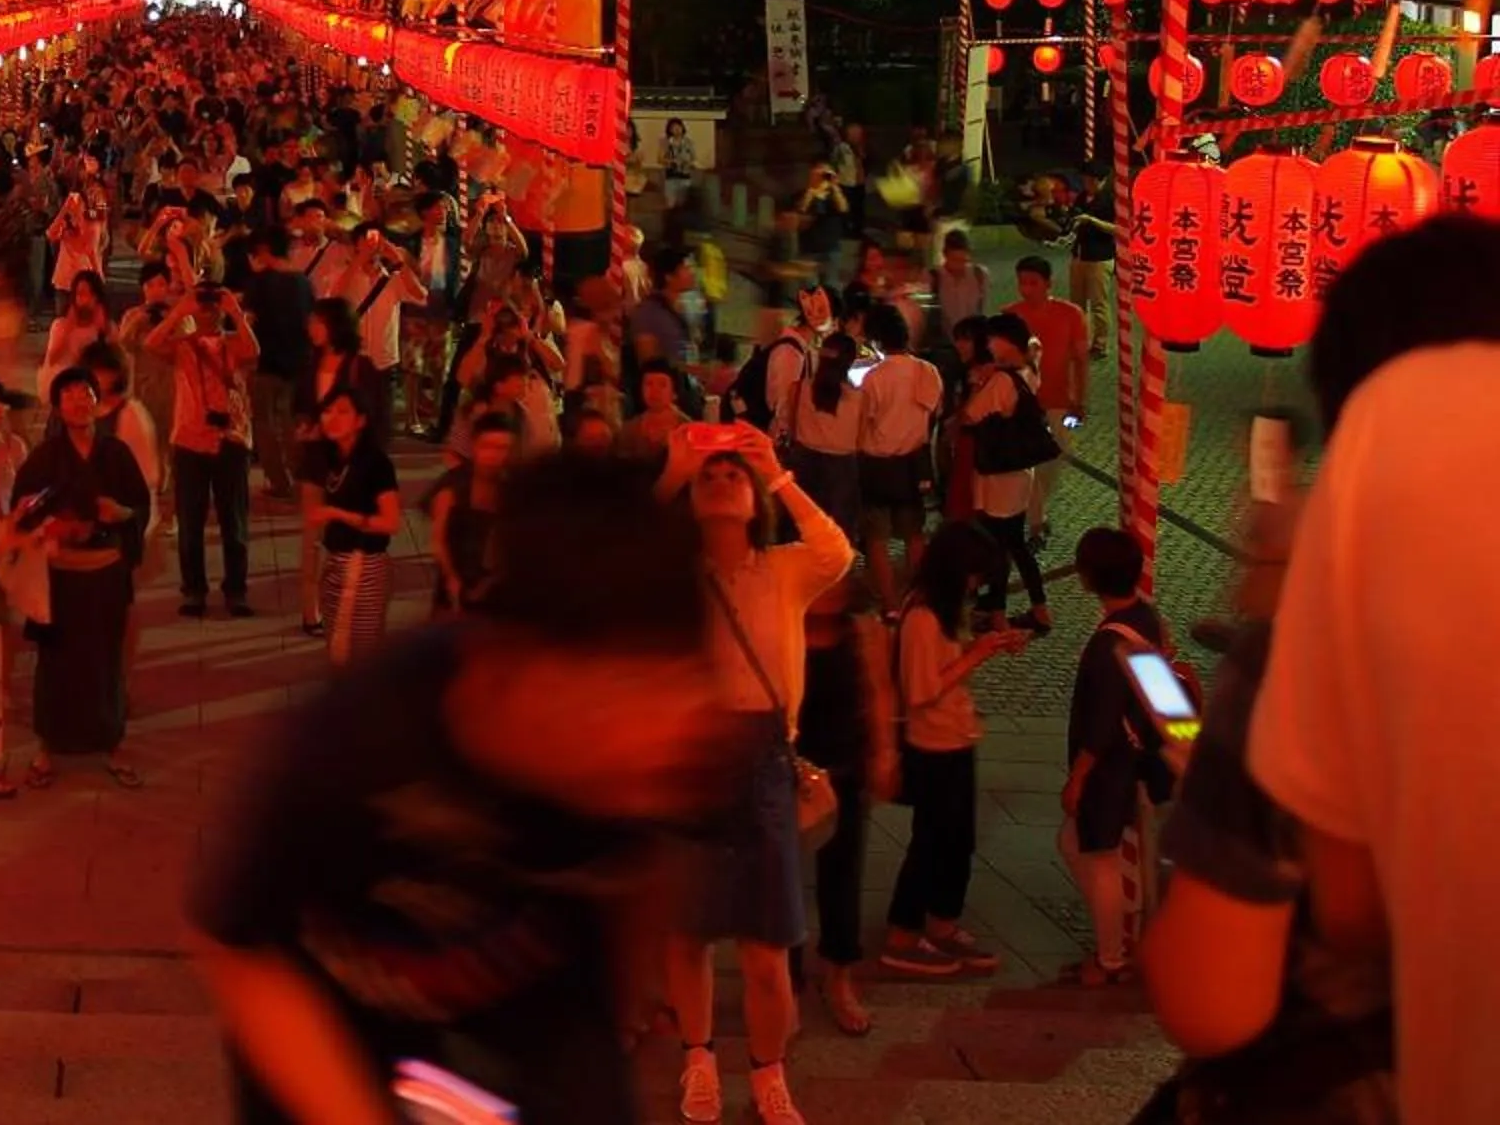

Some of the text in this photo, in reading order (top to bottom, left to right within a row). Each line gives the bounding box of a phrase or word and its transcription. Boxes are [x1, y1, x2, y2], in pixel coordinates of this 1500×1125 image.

[1170, 206, 1201, 291] 本宮祭
[1276, 207, 1307, 298] 本宮祭
